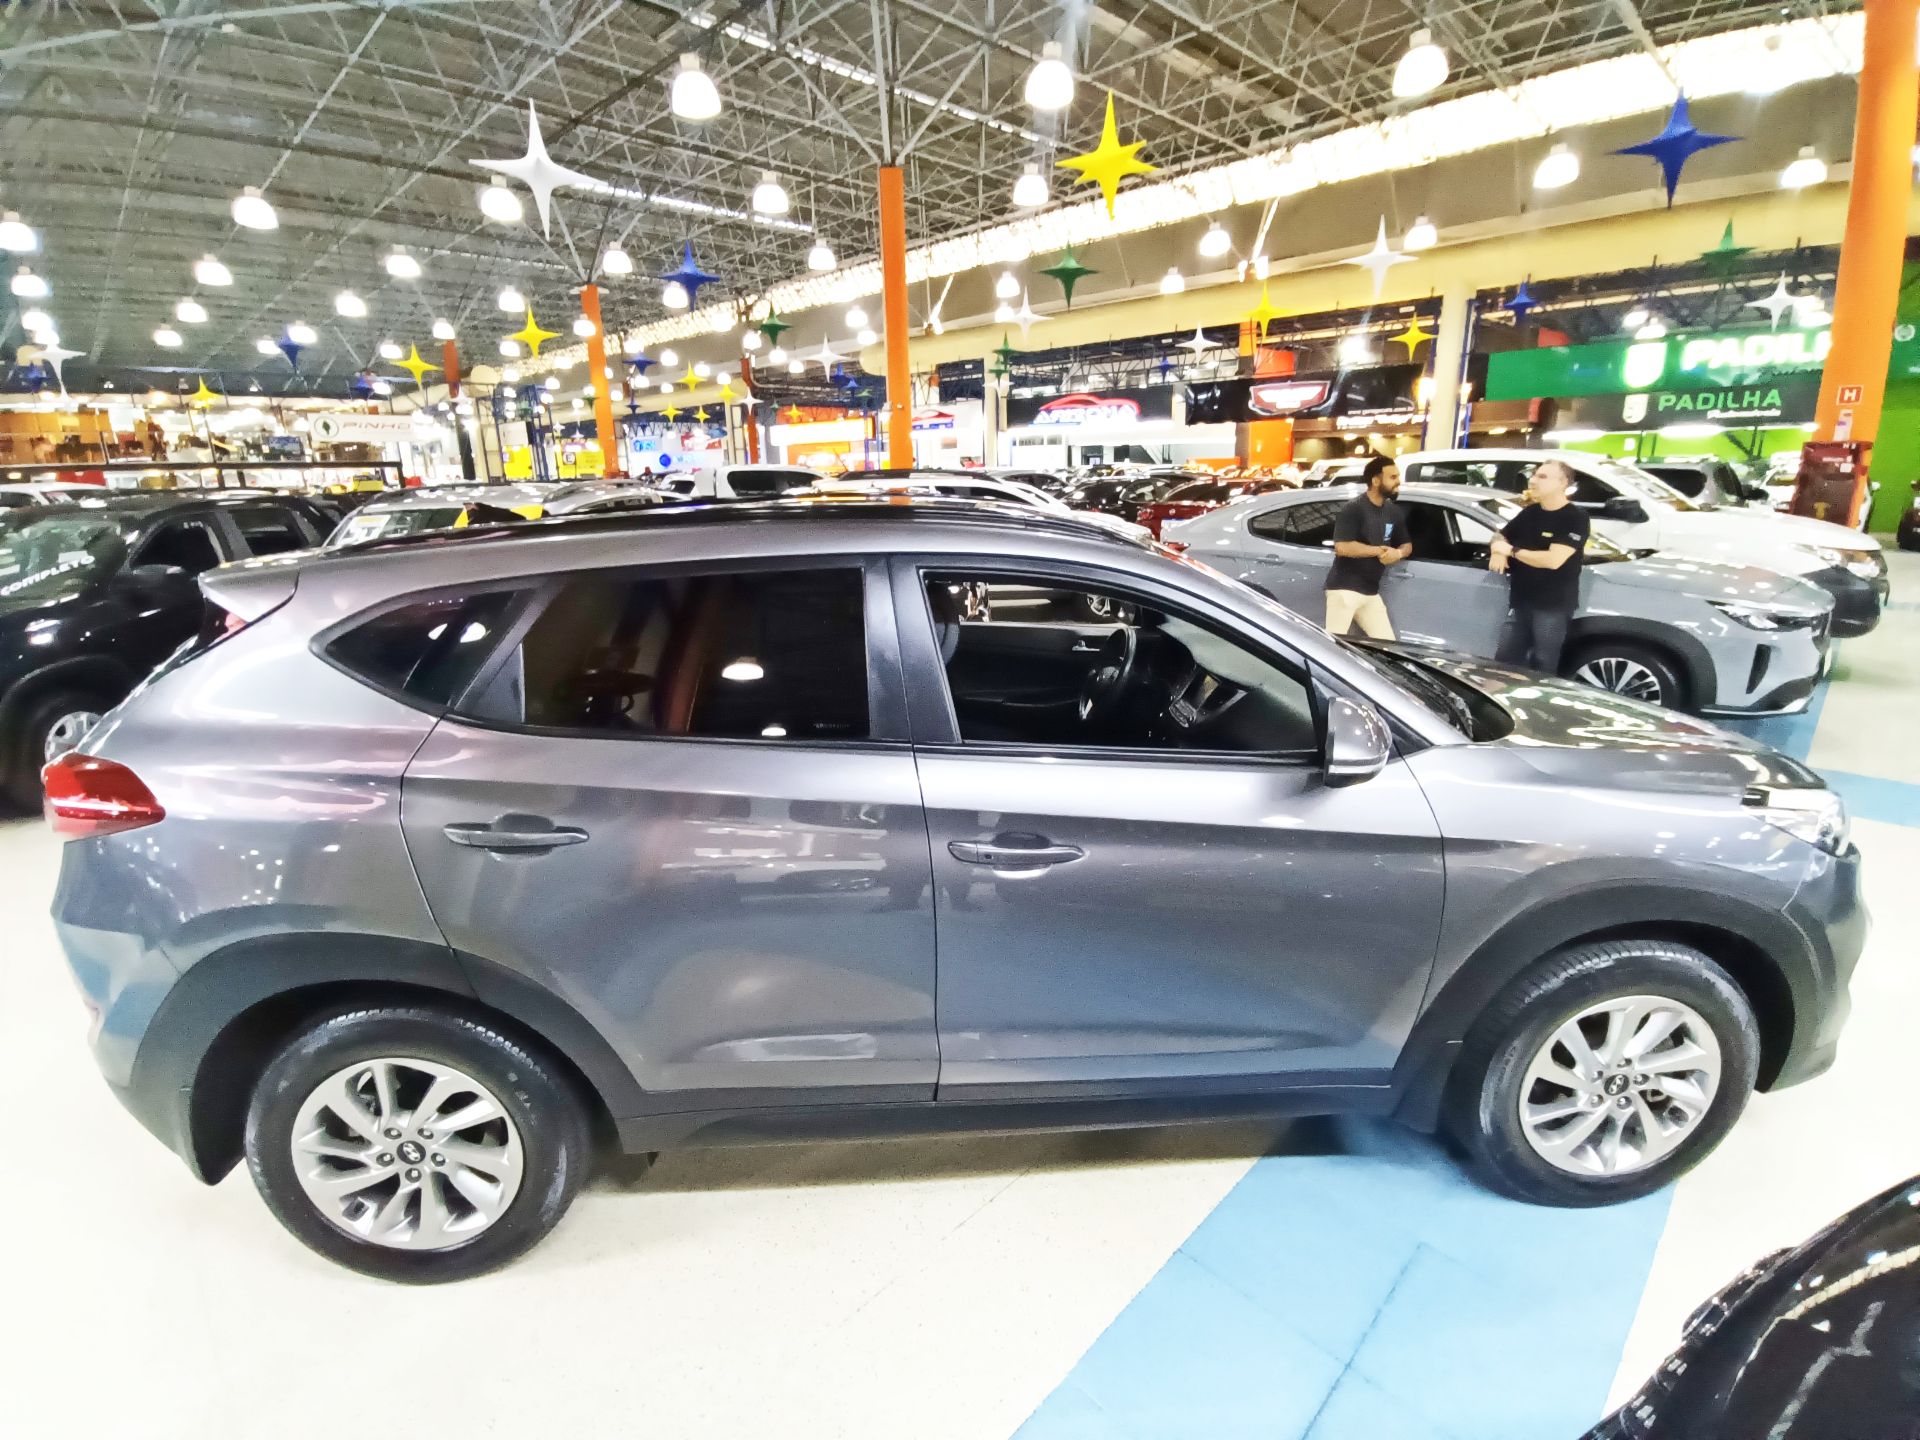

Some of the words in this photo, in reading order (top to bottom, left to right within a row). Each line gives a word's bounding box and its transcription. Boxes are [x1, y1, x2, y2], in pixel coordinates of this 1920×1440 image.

[1658, 389, 1782, 412] PADILHA
[1843, 388, 1857, 401] H
[342, 422, 411, 430] PINHO
[0, 555, 95, 596] COMPLETO
